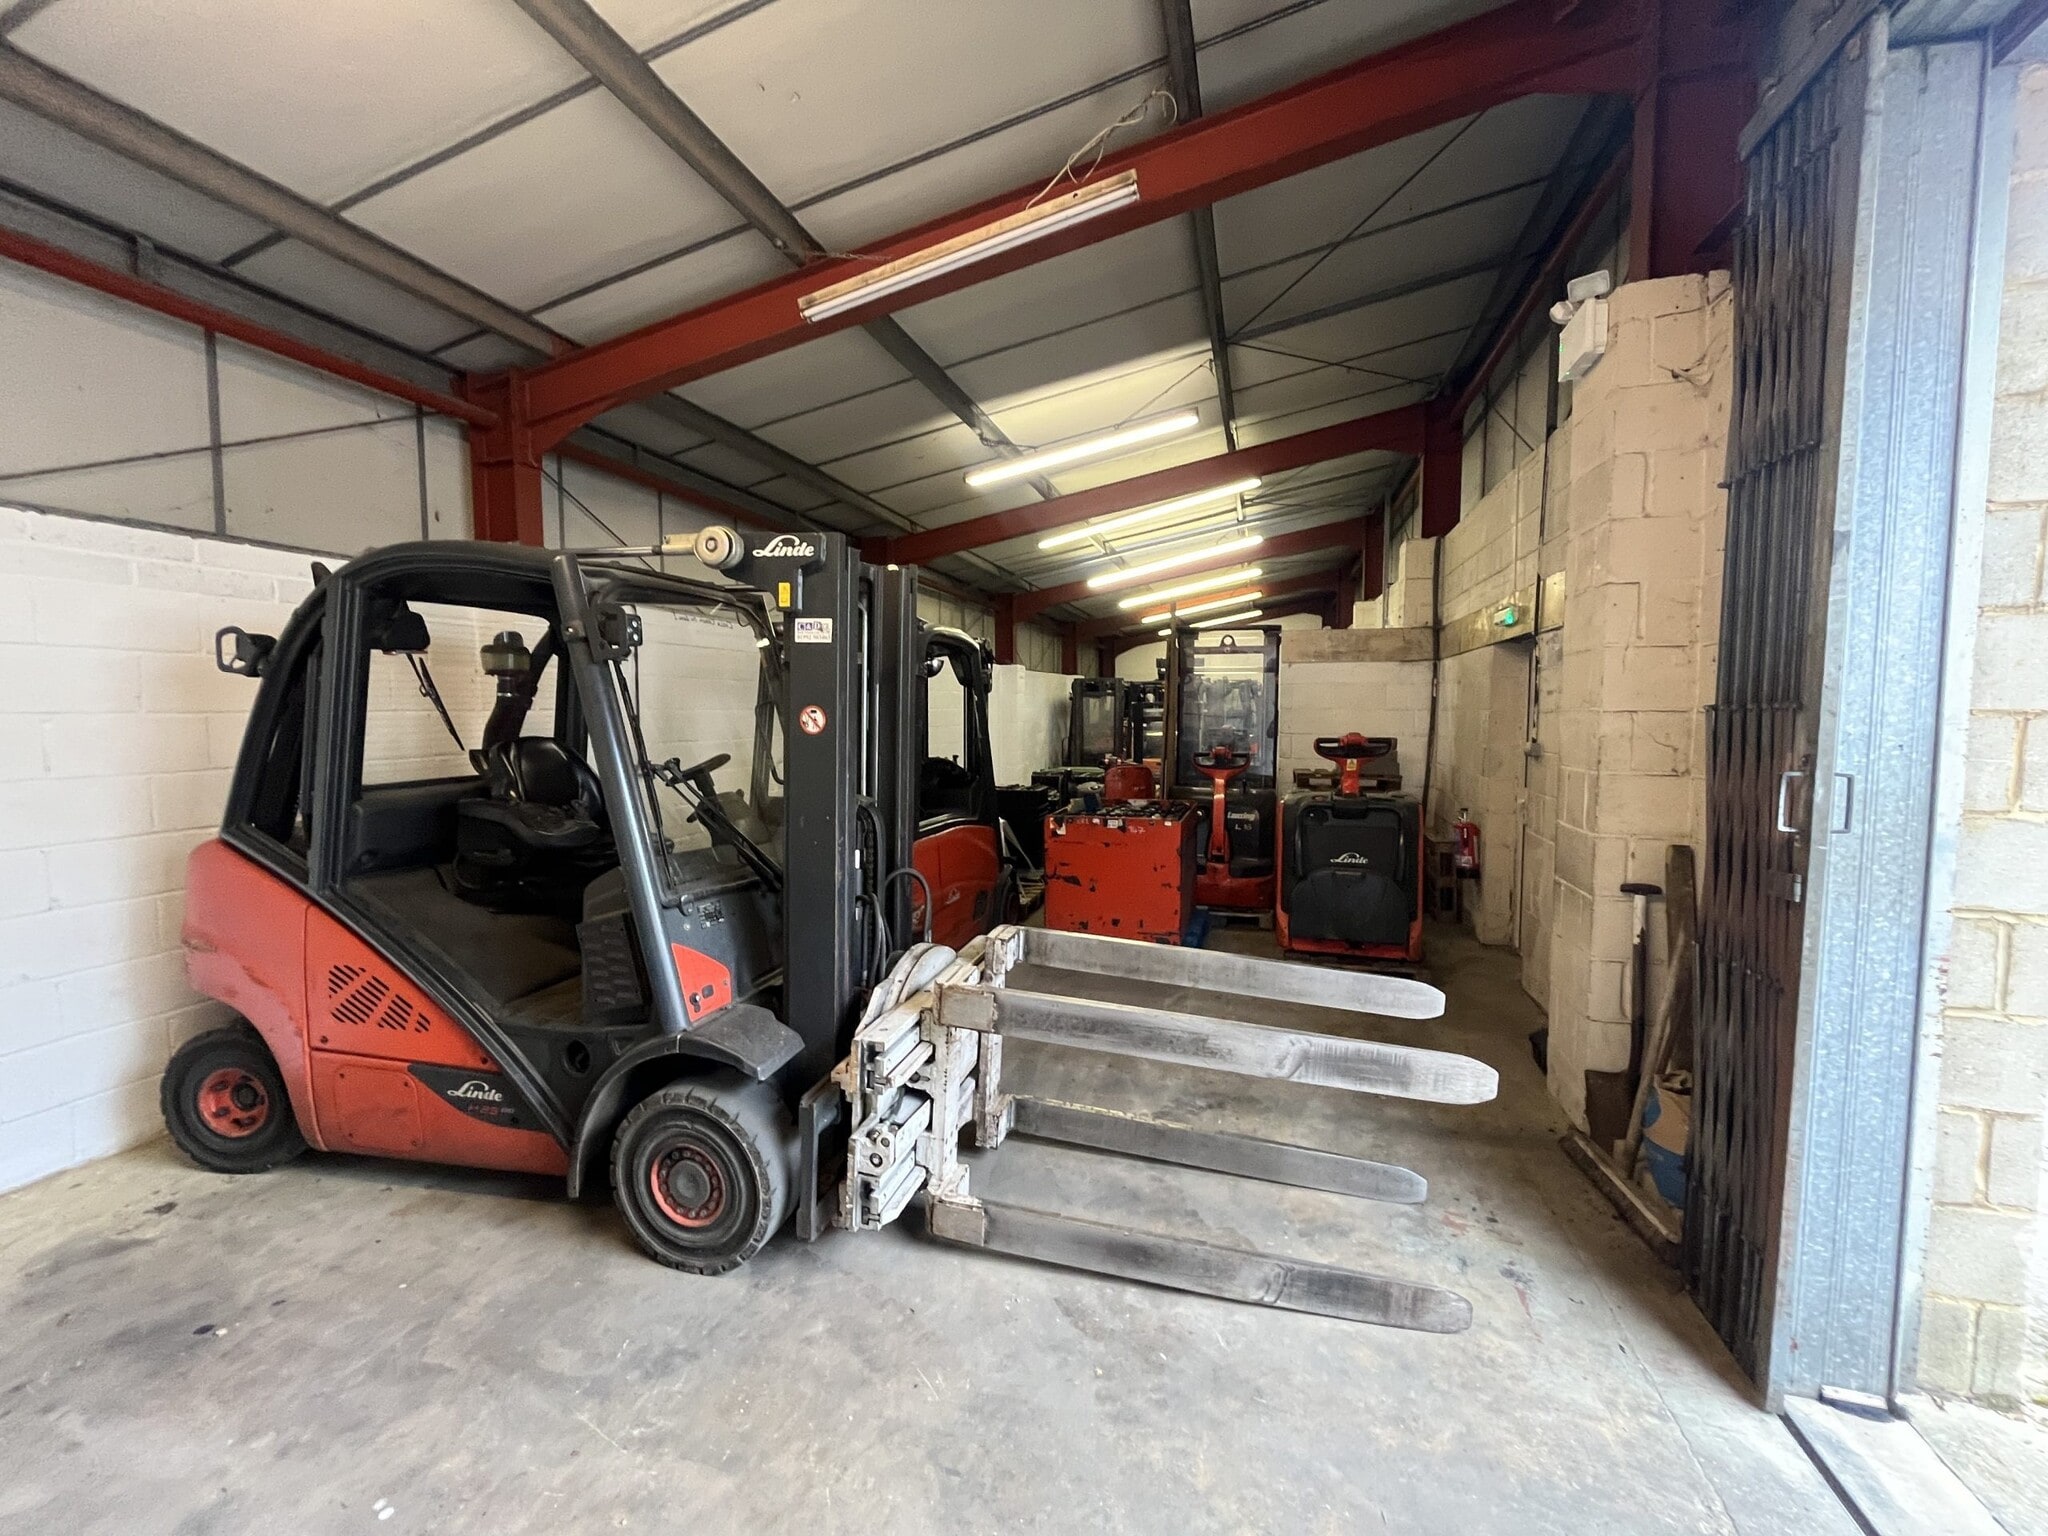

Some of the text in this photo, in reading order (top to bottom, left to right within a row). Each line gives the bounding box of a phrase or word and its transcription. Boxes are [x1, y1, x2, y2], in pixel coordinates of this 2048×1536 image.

[752, 534, 815, 557] Linde
[1330, 851, 1369, 864] Linde
[446, 1080, 503, 1102] Linde
